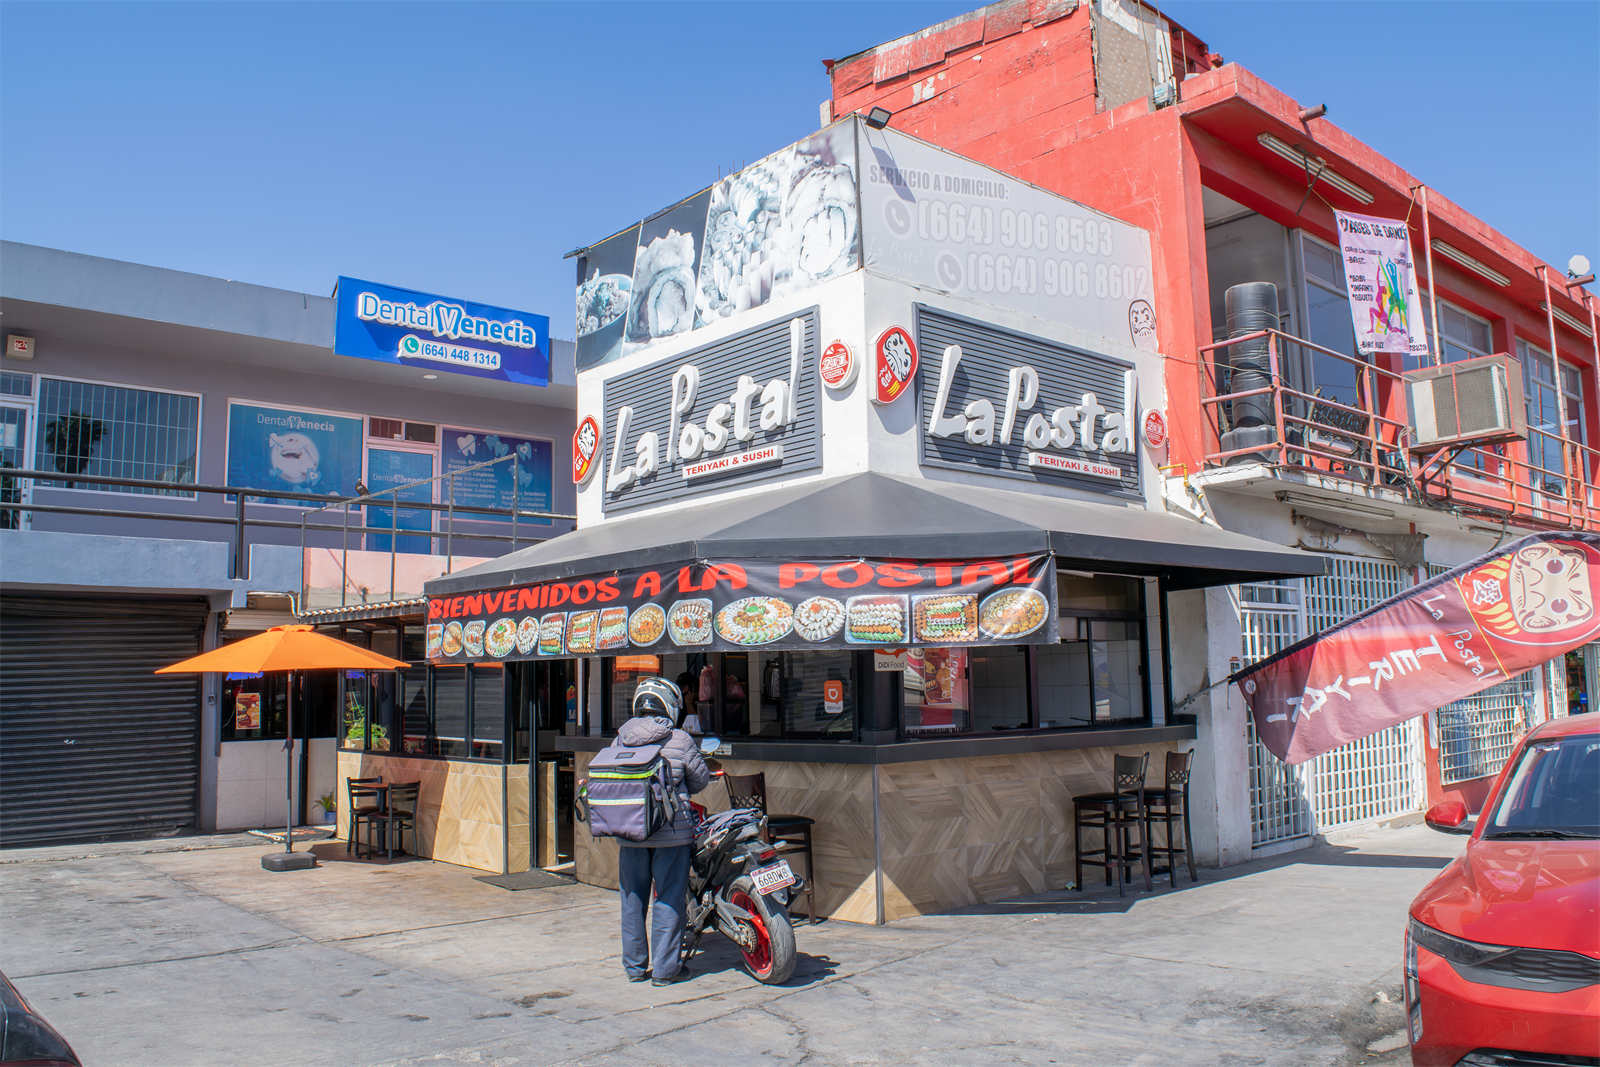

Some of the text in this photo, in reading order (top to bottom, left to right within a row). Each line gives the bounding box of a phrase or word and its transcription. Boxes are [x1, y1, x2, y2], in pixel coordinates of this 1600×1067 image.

[869, 164, 1009, 200] SERVICIO A DOMICILIO:
[917, 198, 1114, 257] (664) 906 8593
[967, 252, 1148, 300] (664) 906 8602
[421, 342, 498, 366] (664) 448 1314
[606, 318, 805, 492] La Postal
[928, 344, 1138, 454] La Postal
[686, 448, 774, 476] TERIYAKI & SUSHI
[1038, 456, 1118, 477] TERIYAKI & SUSHI
[428, 554, 1042, 620] BIENVENIDOS A LA POSTAL
[1422, 594, 1500, 681] La Postal
[1266, 634, 1448, 723] TERIYAKI
